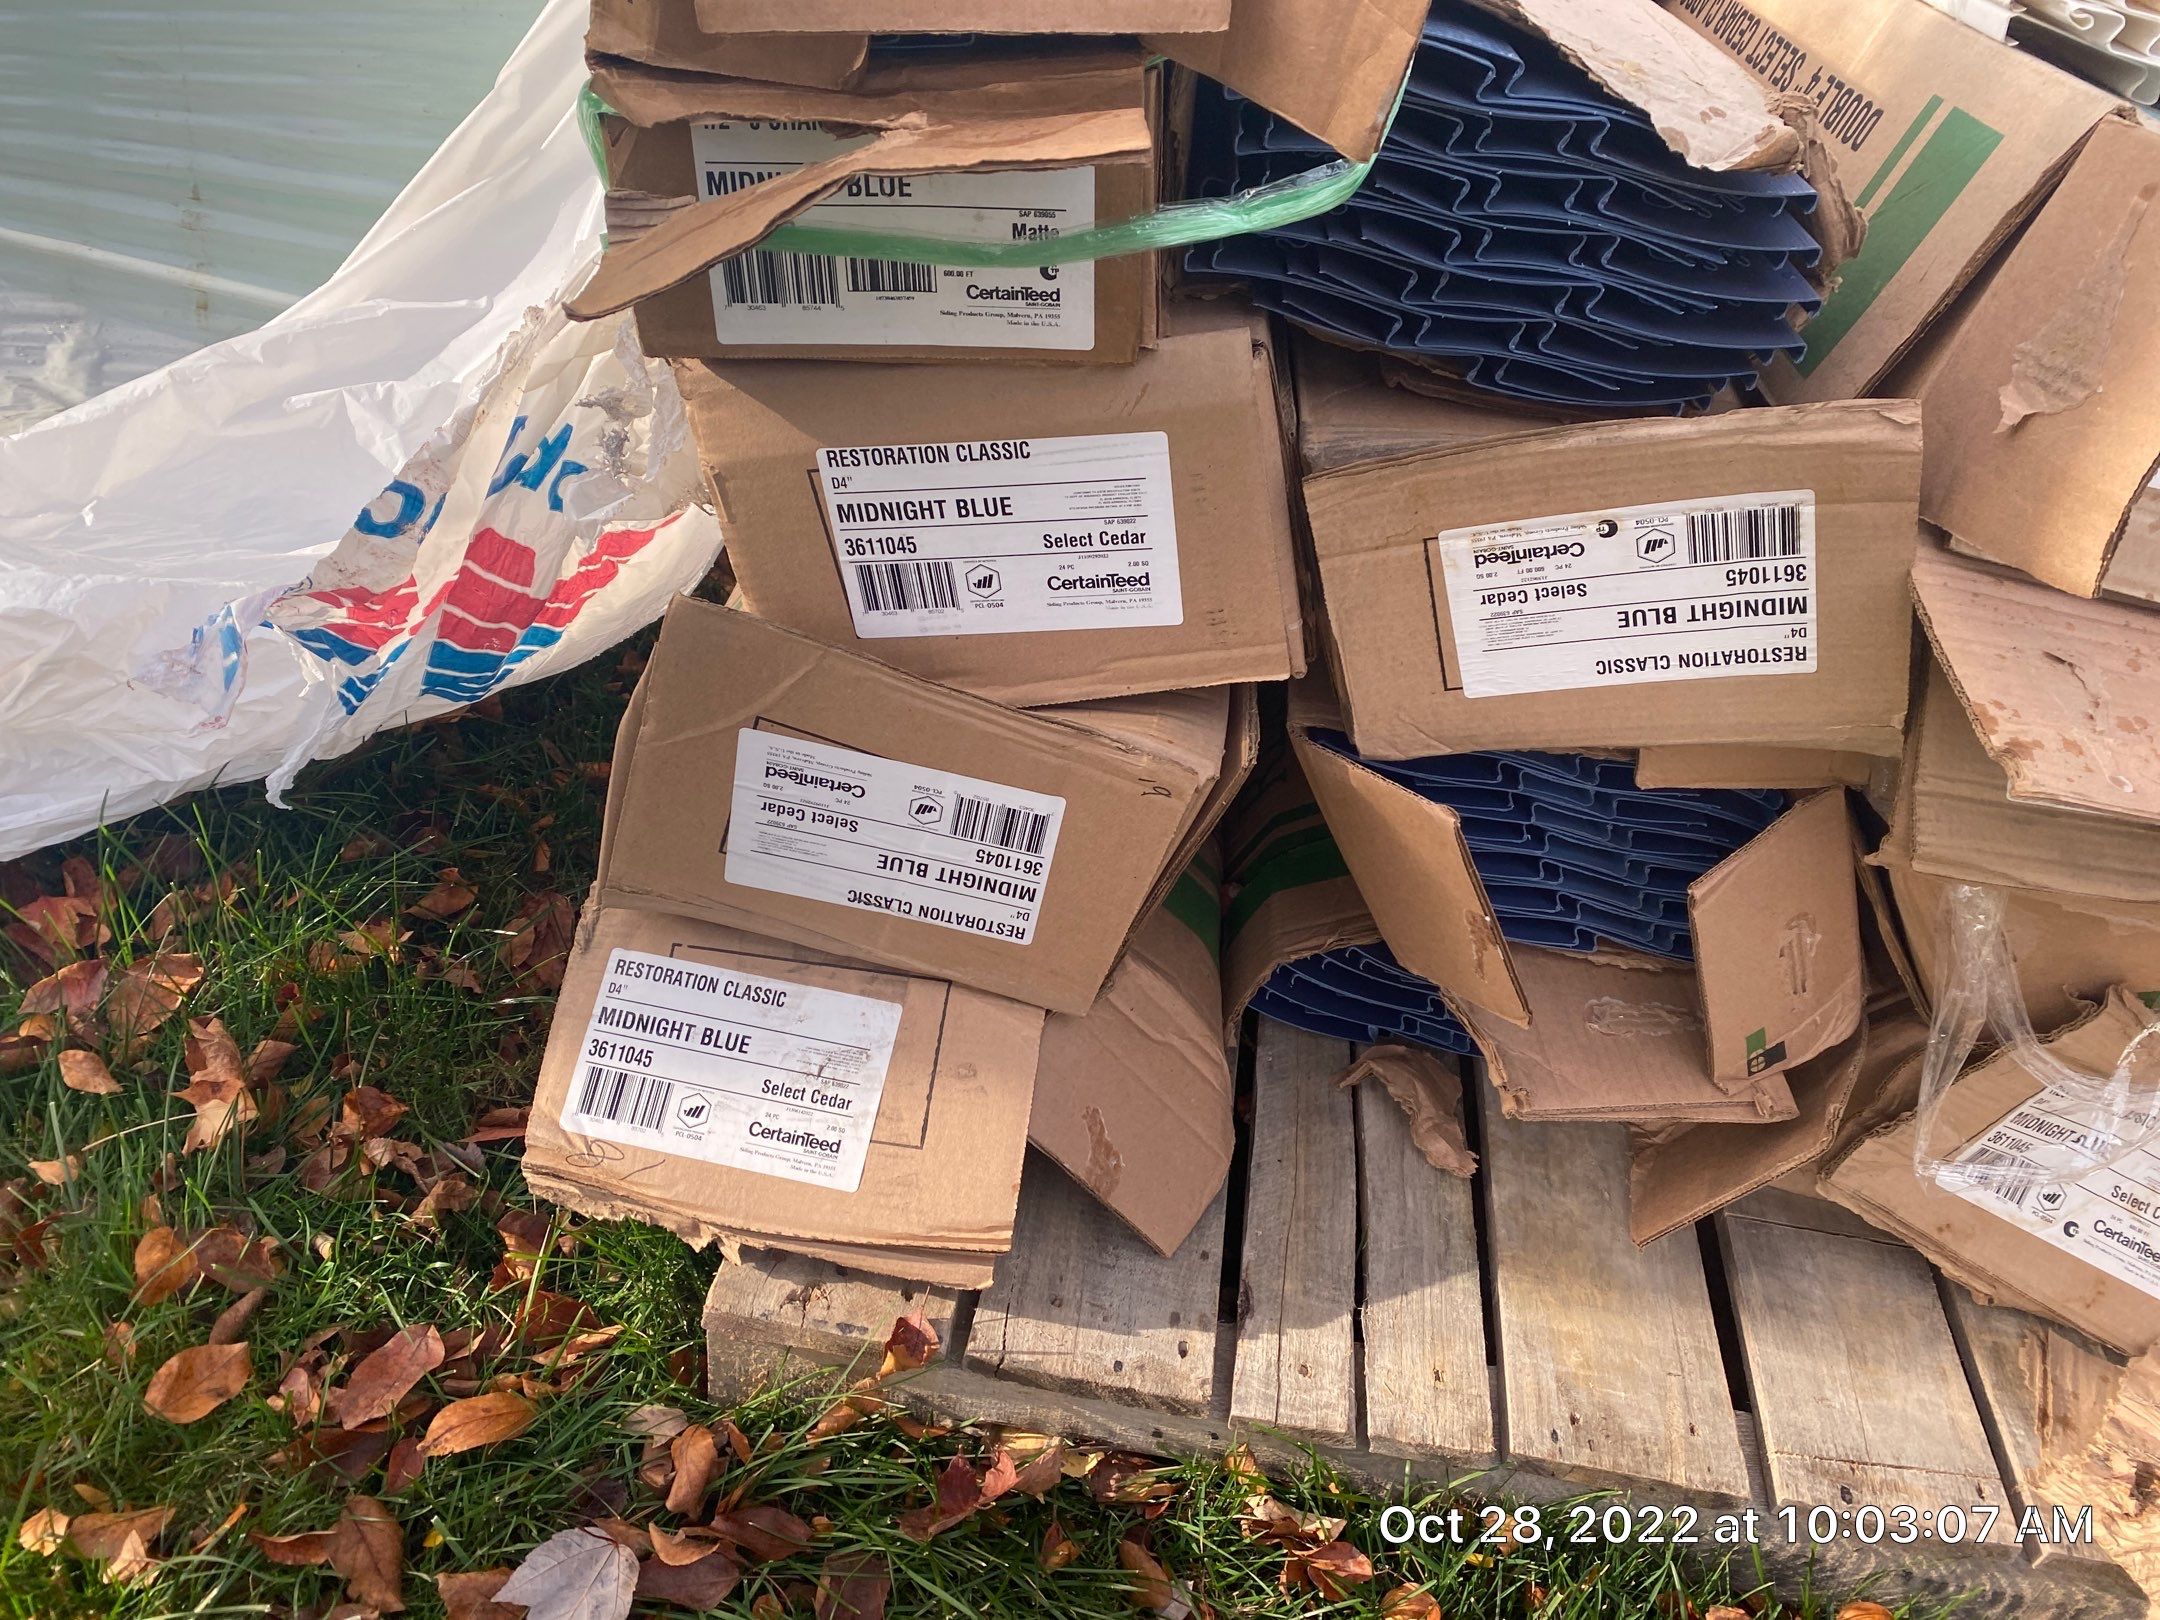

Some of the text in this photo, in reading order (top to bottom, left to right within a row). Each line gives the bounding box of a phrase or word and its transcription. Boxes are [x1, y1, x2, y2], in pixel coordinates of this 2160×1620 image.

[1713, 0, 1761, 55] CEDAR
[1745, 26, 1807, 92] SELECT
[1816, 74, 1884, 152] DOUBLE
[1018, 209, 1032, 217] SAP
[1012, 222, 1059, 240] Matte
[965, 284, 1060, 302] CertainTeed
[825, 440, 1030, 467] RESTORATION CLASSIC
[830, 476, 852, 489] D4"
[836, 496, 1013, 523] MIDNIGHT BLUE
[844, 529, 1145, 556] 3611045 Select Cedar
[1473, 542, 1585, 568] CertainTeed
[1046, 571, 1150, 590] CertainTeed
[1480, 563, 1806, 606] 3611045 Select Cedar
[1616, 596, 1807, 628] MIDNIGHT BLUE
[1784, 627, 1806, 638] D4"
[1595, 645, 1806, 674] RESTORATION CLASSIC
[764, 765, 865, 798] CertainTeed
[760, 801, 805, 821] Cedar
[810, 811, 858, 832] Select
[975, 848, 1042, 876] 3611045
[876, 853, 1036, 902] MIDNIGHT BLUE
[847, 889, 1025, 939] RESTORATION CLASSIC
[1010, 910, 1030, 921] D4"
[607, 981, 628, 994] D4"
[614, 958, 786, 1007] RESTORATION CLASSIC
[597, 1006, 751, 1054] MIDNIGHT BLUE
[588, 1038, 852, 1110] 3611045 Select Cedar
[748, 1121, 841, 1153] CertainTeed
[1988, 1131, 2034, 1153] 3611045
[2111, 1185, 2151, 1214] Select
